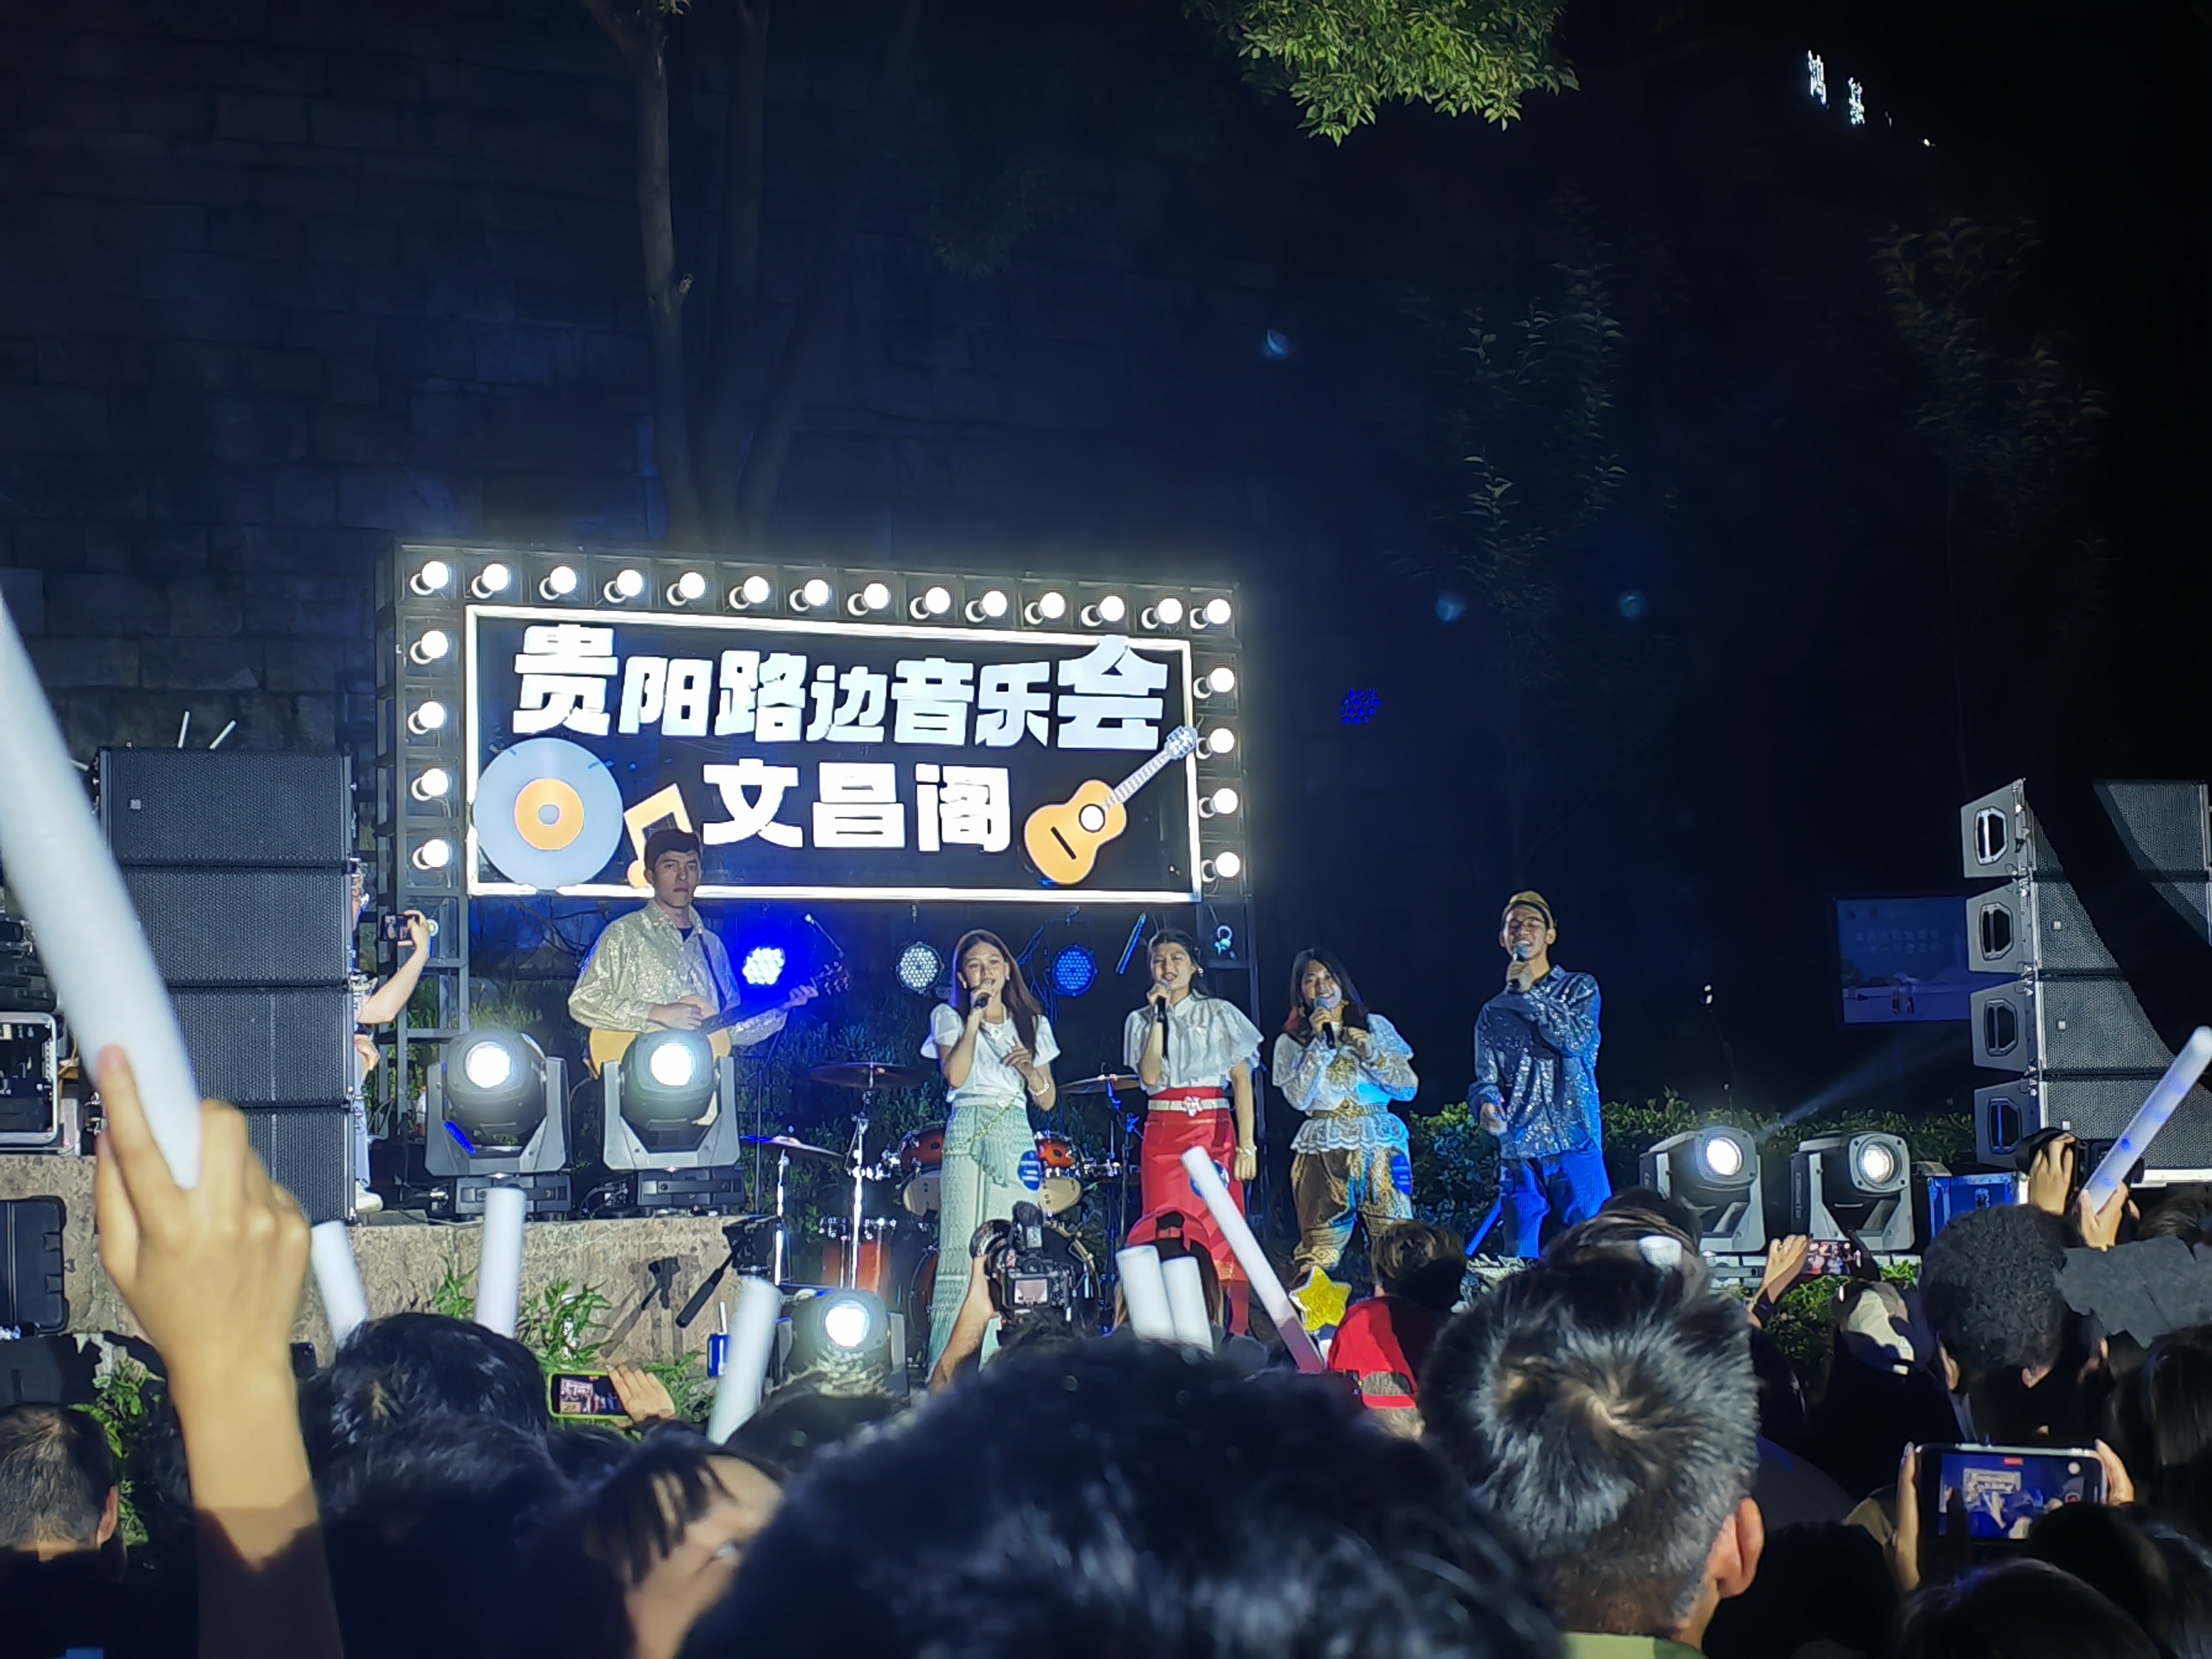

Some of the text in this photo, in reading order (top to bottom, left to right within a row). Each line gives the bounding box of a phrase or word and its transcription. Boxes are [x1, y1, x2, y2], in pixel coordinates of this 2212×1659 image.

[513, 623, 1169, 750] 贵阳路边音乐会
[703, 758, 1011, 853] 文昌阁
